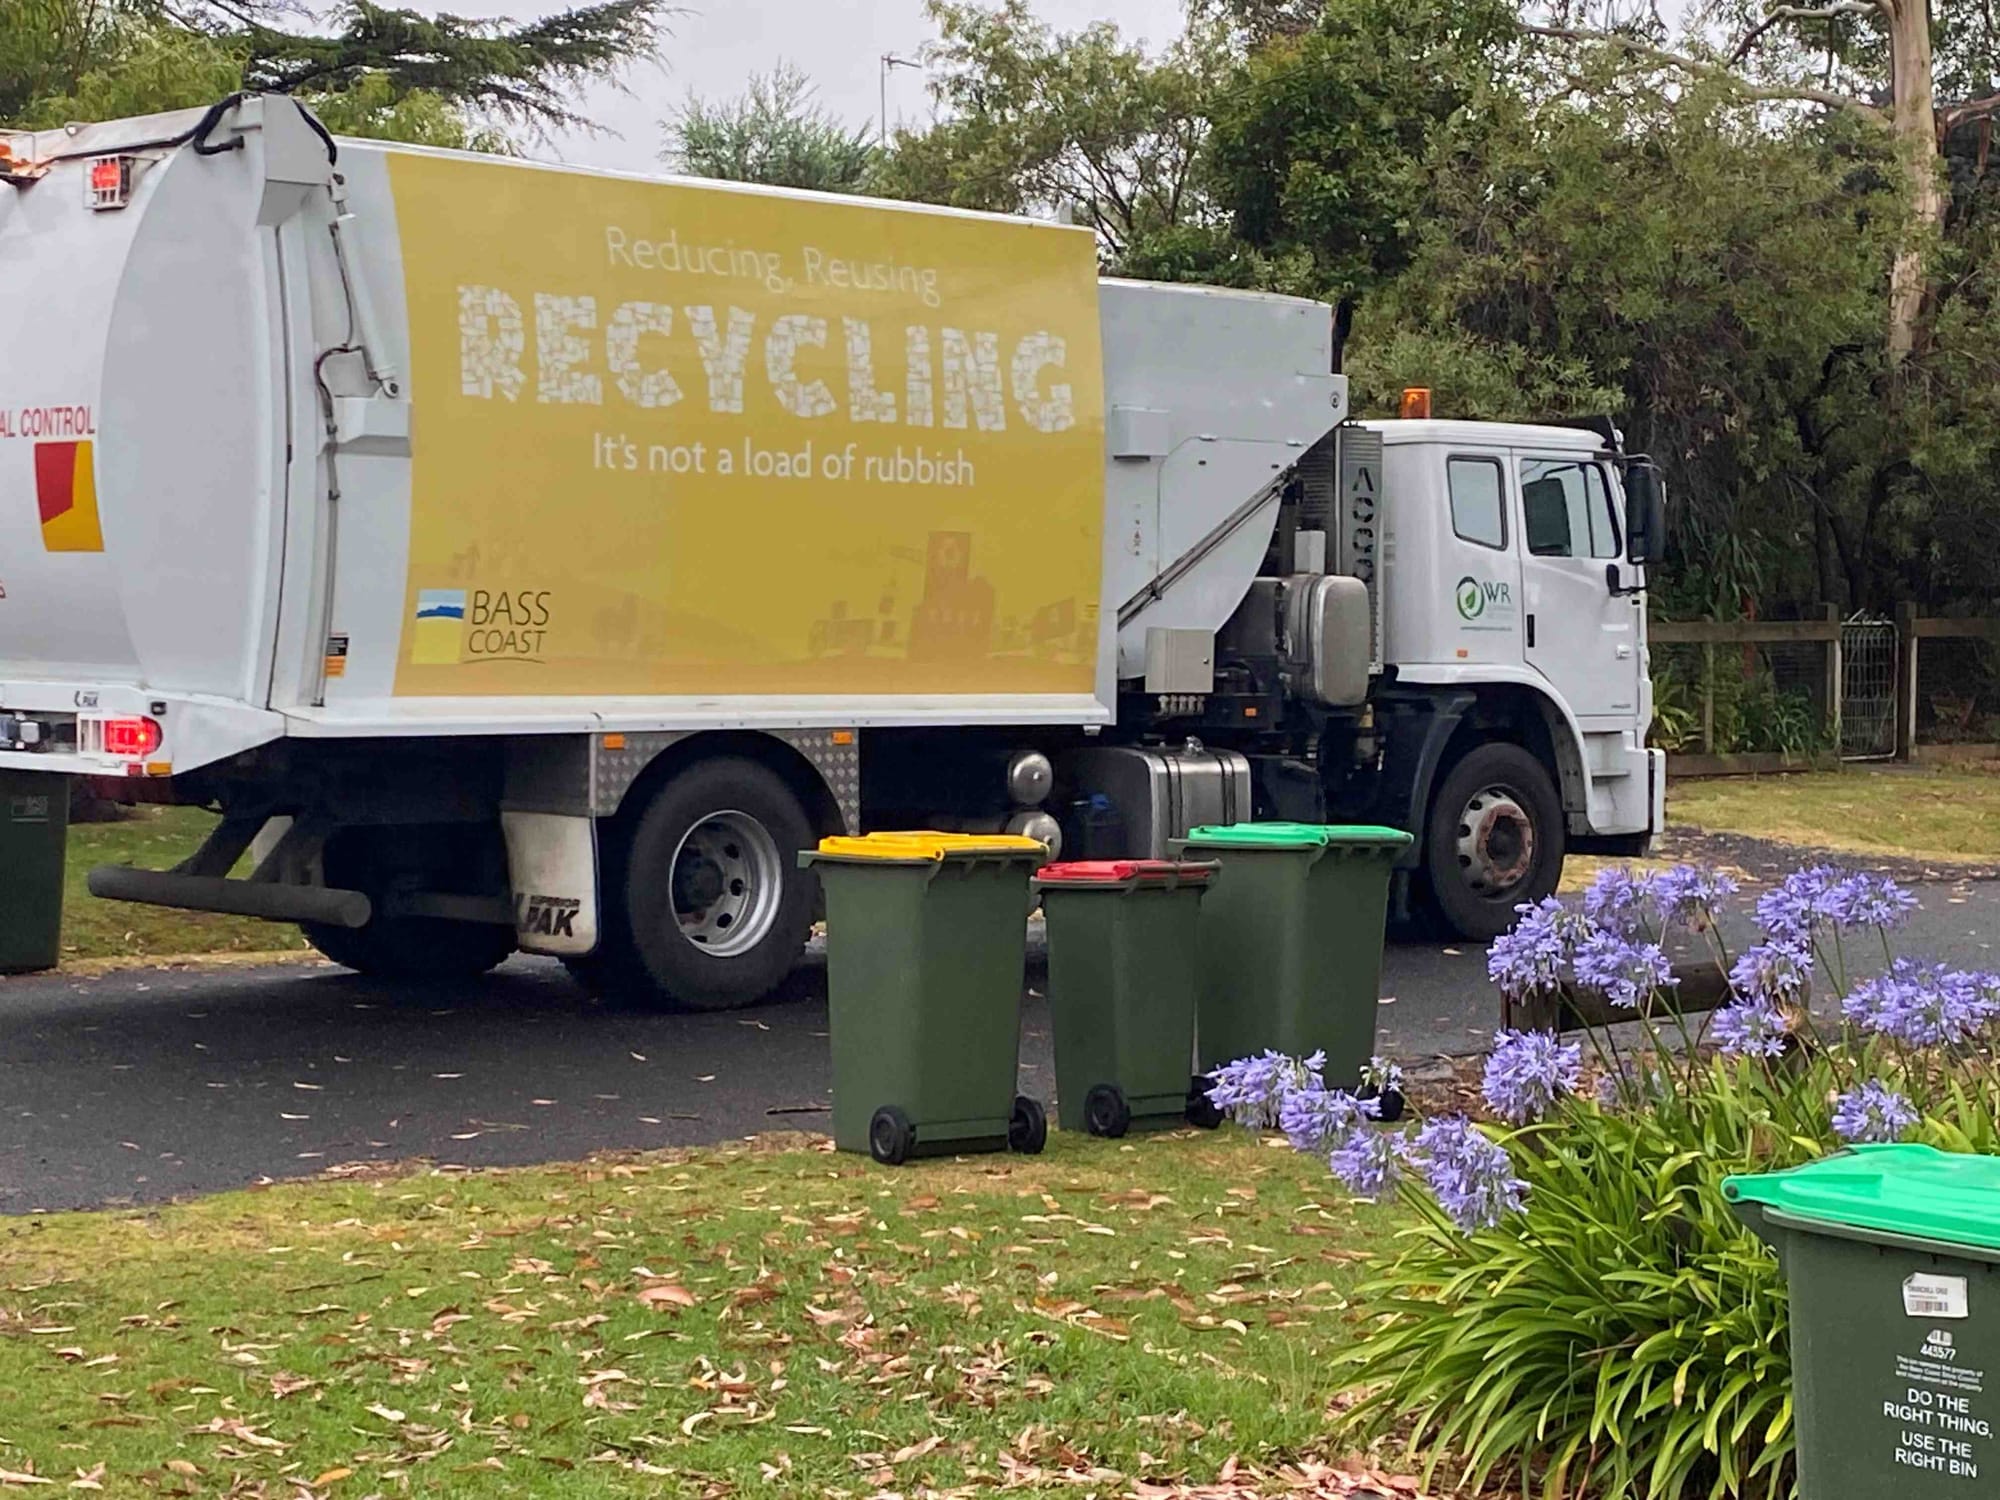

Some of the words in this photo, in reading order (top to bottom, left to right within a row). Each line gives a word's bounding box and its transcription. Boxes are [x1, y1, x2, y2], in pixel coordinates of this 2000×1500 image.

[606, 226, 793, 294] Reducing,
[803, 246, 941, 308] Reusing
[458, 285, 1076, 432] RECYCLING
[20, 405, 96, 437] CONTROL
[593, 433, 638, 471] It's
[649, 441, 706, 474] not
[717, 448, 734, 475] a
[745, 437, 812, 478] load
[822, 442, 857, 481] of
[864, 445, 975, 486] rubbish
[472, 590, 551, 626] BASS
[468, 629, 547, 654] COAST
[1907, 1387, 1933, 1406] DO
[1936, 1393, 1970, 1414] THE
[1883, 1401, 1934, 1425] RIGHT
[1937, 1412, 1994, 1440] THING,
[1901, 1430, 1936, 1451] USE
[1938, 1438, 1973, 1459] THE
[1895, 1447, 1946, 1472] RIGHT
[1949, 1458, 1978, 1479] BIN
